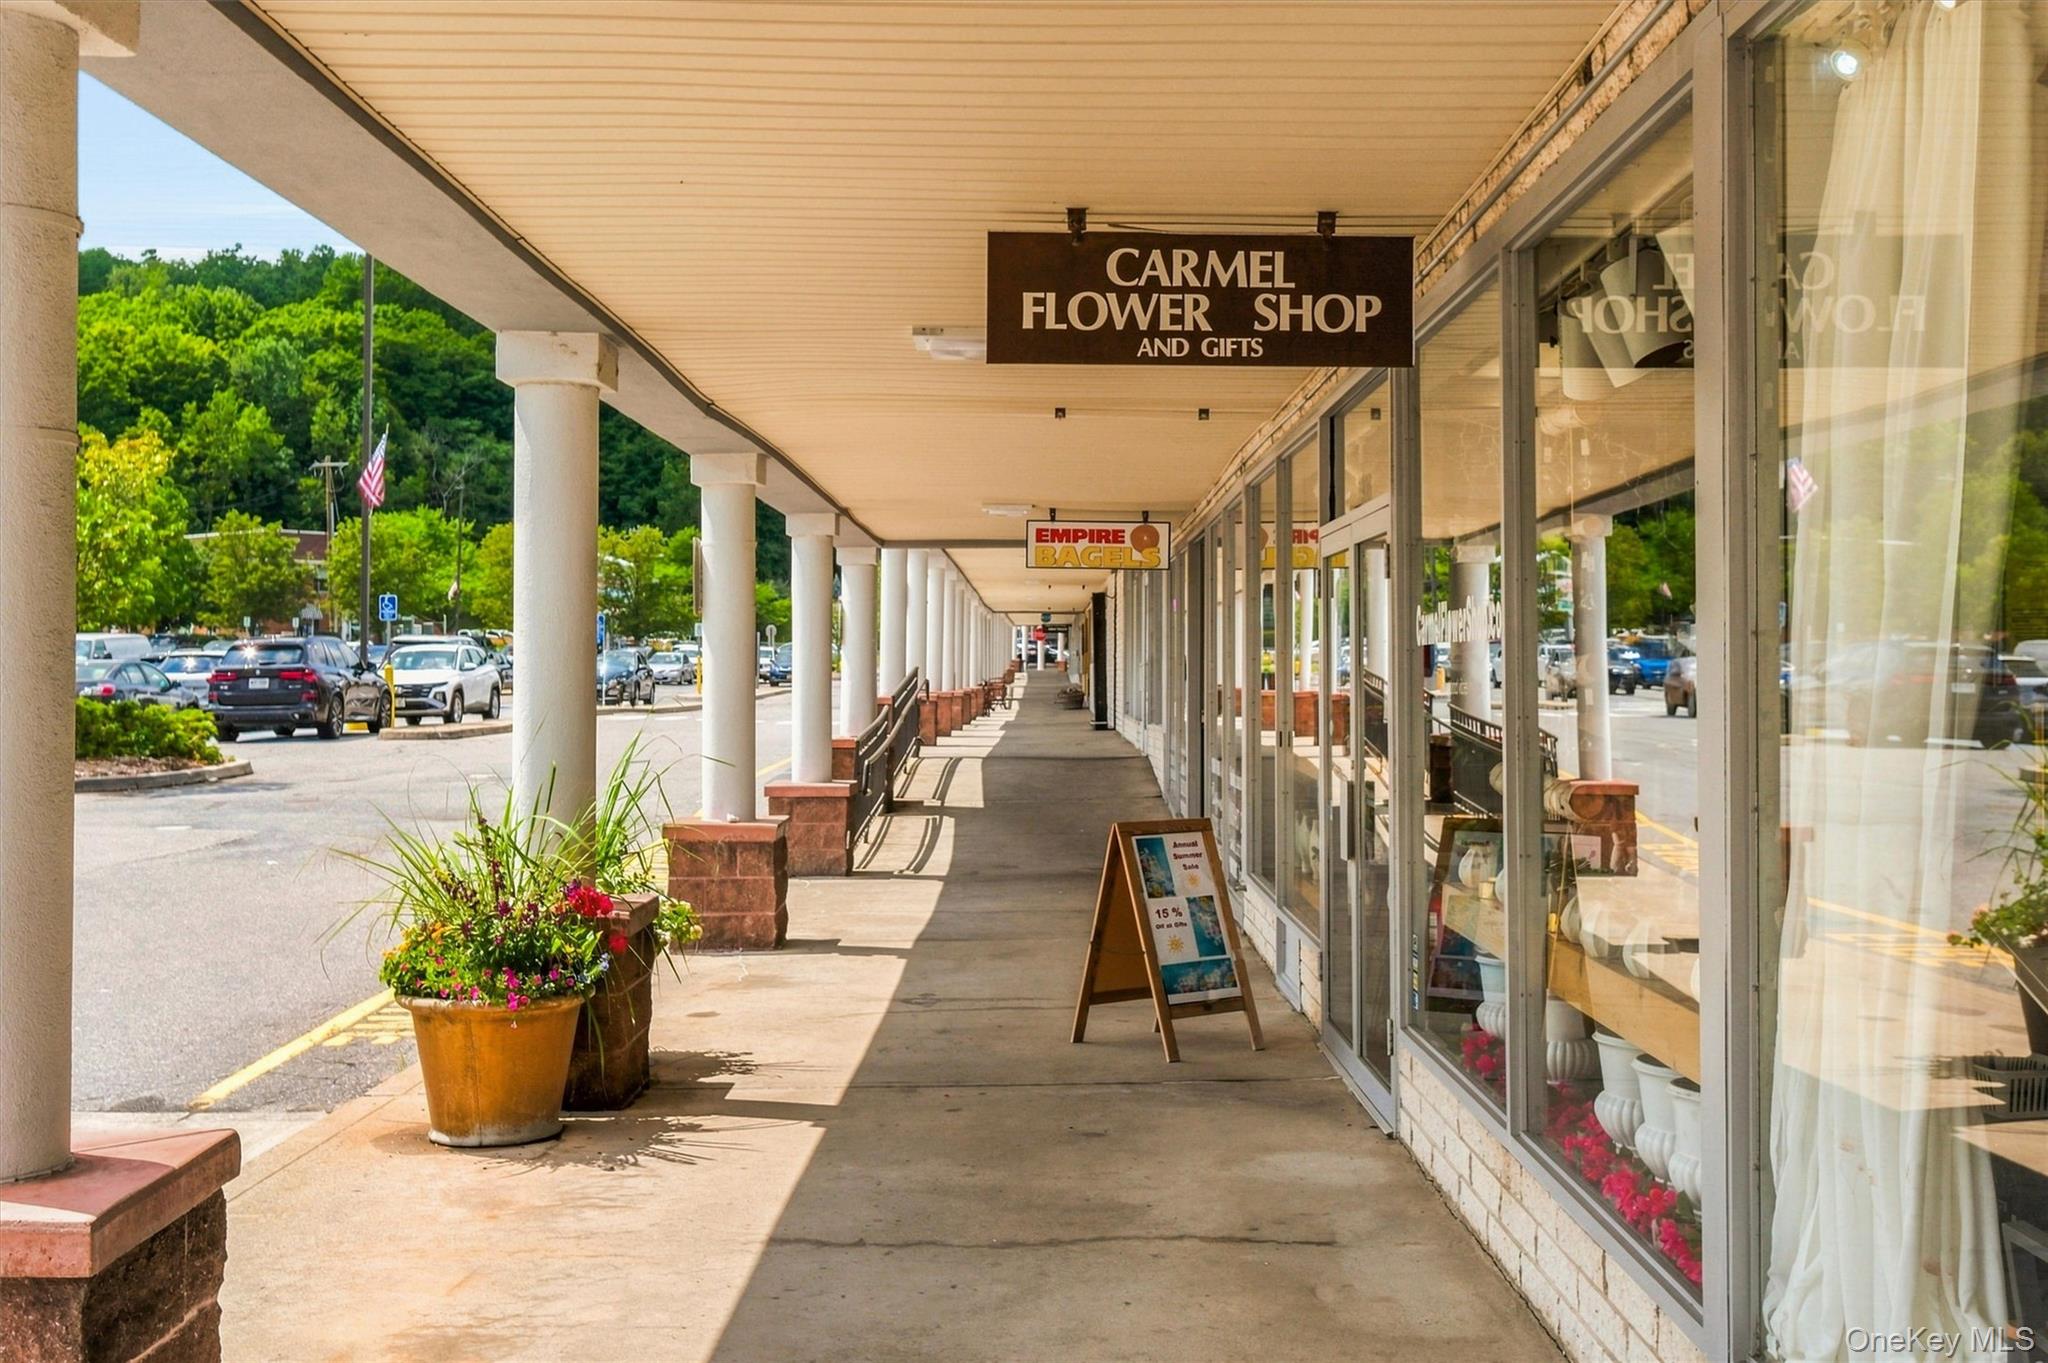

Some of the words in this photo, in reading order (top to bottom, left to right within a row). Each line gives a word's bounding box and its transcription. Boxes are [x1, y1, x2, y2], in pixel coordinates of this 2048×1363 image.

[1106, 247, 1296, 289] CARMEL
[1021, 291, 1213, 331] FLOWER
[1253, 293, 1382, 333] SHOP
[1137, 336, 1189, 357] AND
[1201, 337, 1264, 358] GIFTS
[1035, 527, 1126, 544] EMPIRE
[1034, 545, 1161, 568] BAGELS
[1173, 840, 1198, 848] Annual
[1182, 863, 1199, 871] Sale
[1155, 907, 1169, 919] 15
[1171, 906, 1183, 918] %
